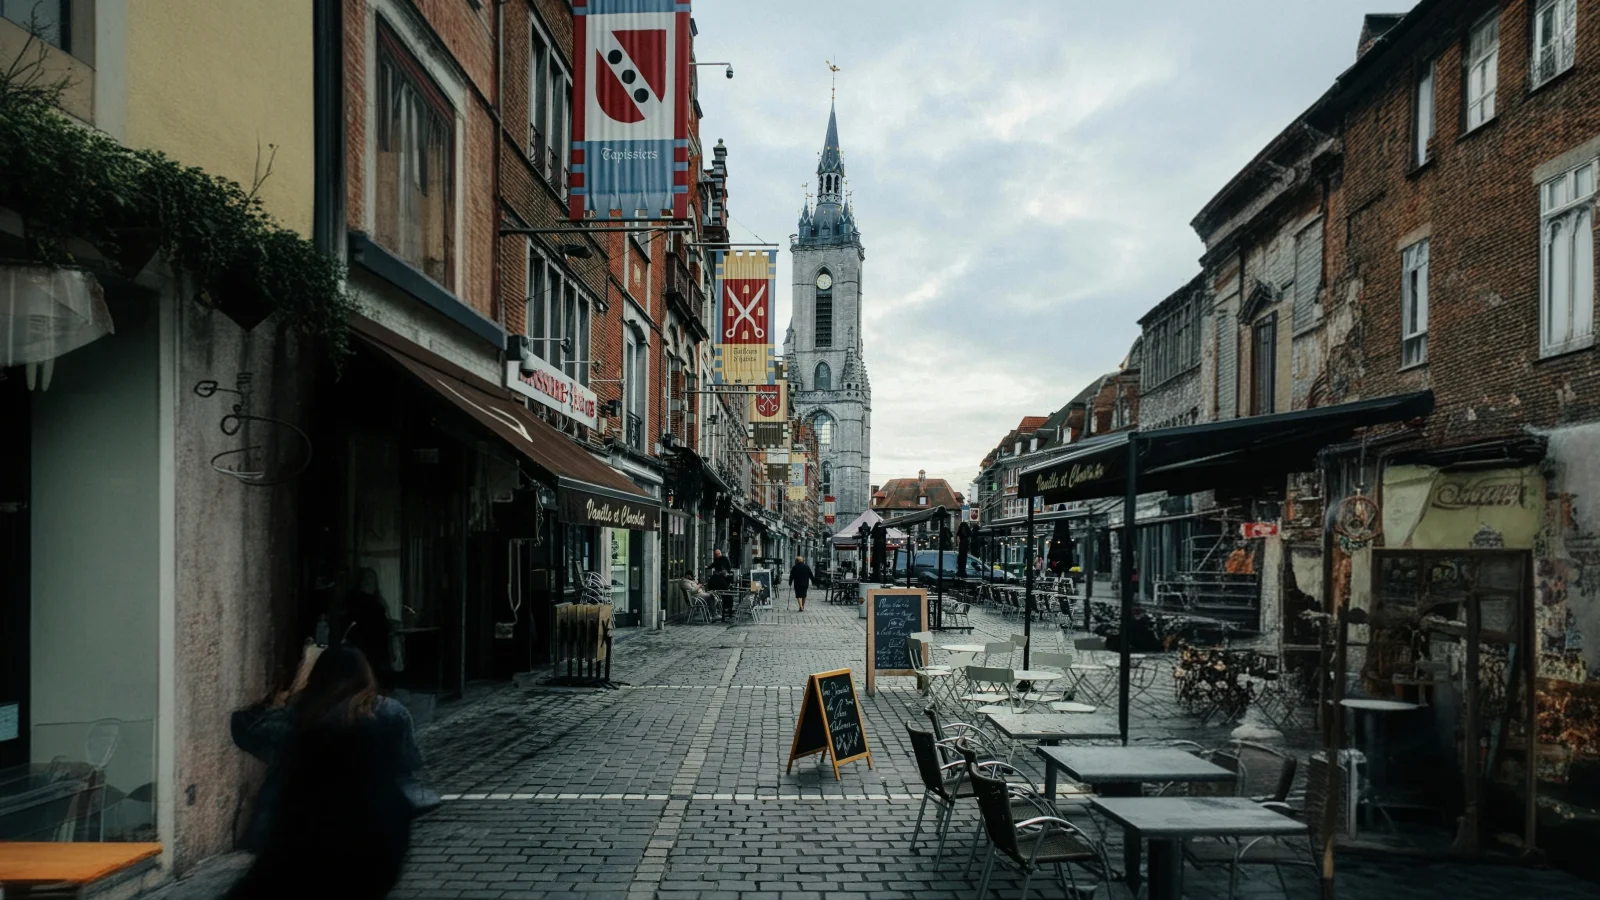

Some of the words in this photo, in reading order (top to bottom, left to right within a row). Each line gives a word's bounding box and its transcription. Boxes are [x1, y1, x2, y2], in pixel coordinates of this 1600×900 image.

[601, 147, 658, 163] Tapissiers
[1036, 471, 1059, 492] Vanille
[1060, 471, 1068, 487] et
[586, 498, 612, 522] Vanille
[613, 508, 620, 523] et
[620, 505, 646, 527] Chocolat
